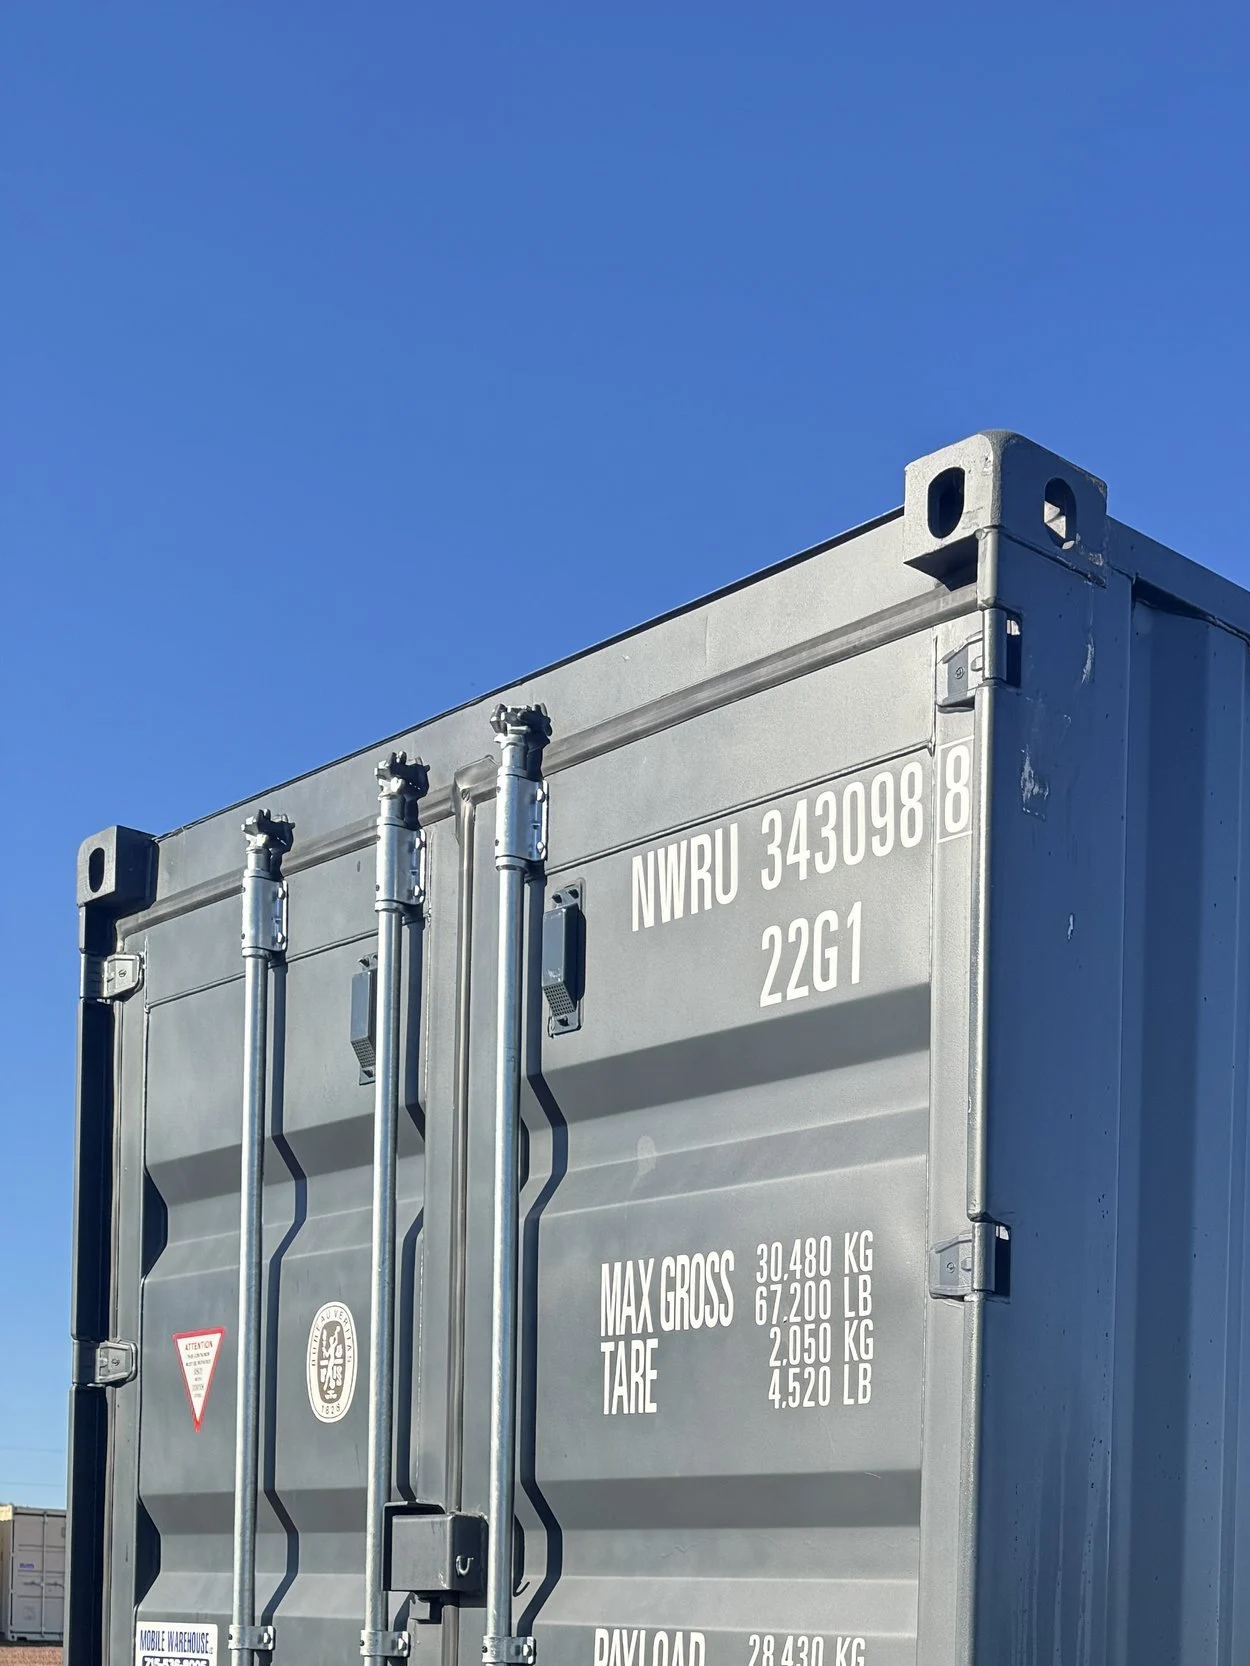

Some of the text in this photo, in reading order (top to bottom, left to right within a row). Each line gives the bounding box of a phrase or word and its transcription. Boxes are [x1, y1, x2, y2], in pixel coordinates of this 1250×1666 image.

[631, 744, 970, 932] NWRU 343098 8
[759, 901, 862, 1008] 22G1
[756, 1230, 874, 1283] 30,480 KG
[601, 1250, 735, 1337] MAX GROSS
[755, 1274, 872, 1326] 67,200 LB
[769, 1318, 874, 1367] 2,050 KG
[600, 1338, 658, 1415] TARE
[768, 1362, 872, 1409] 4,520 LB
[140, 1630, 209, 1653] MOBILE WAREHOUSE
